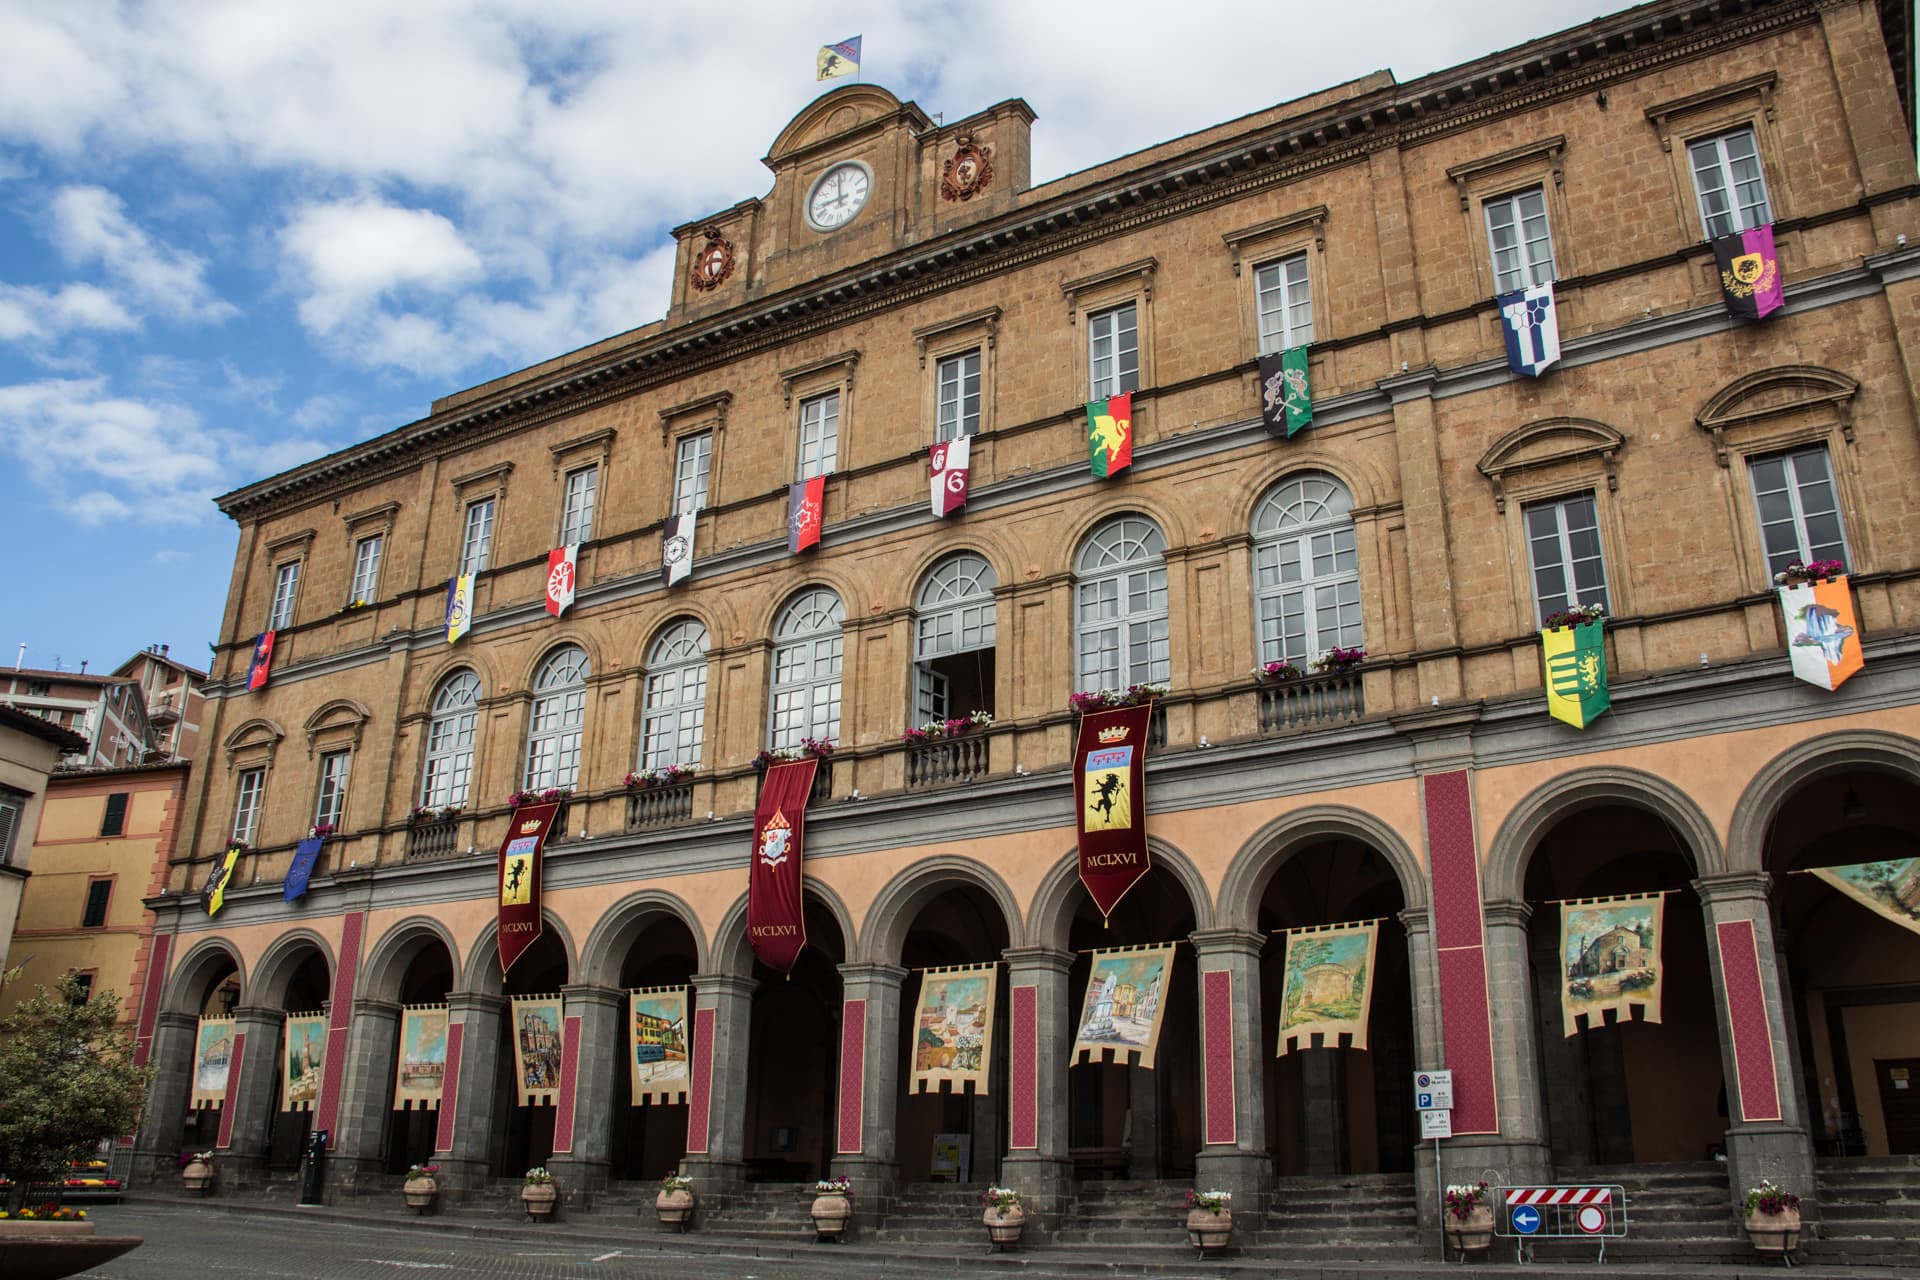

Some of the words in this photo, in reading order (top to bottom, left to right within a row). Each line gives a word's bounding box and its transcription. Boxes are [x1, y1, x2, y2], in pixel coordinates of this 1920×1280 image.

[1087, 852, 1137, 868] MCLXVI
[501, 921, 533, 933] MCLXVI
[752, 924, 797, 937] MCLXVI
[1421, 1095, 1429, 1106] P
